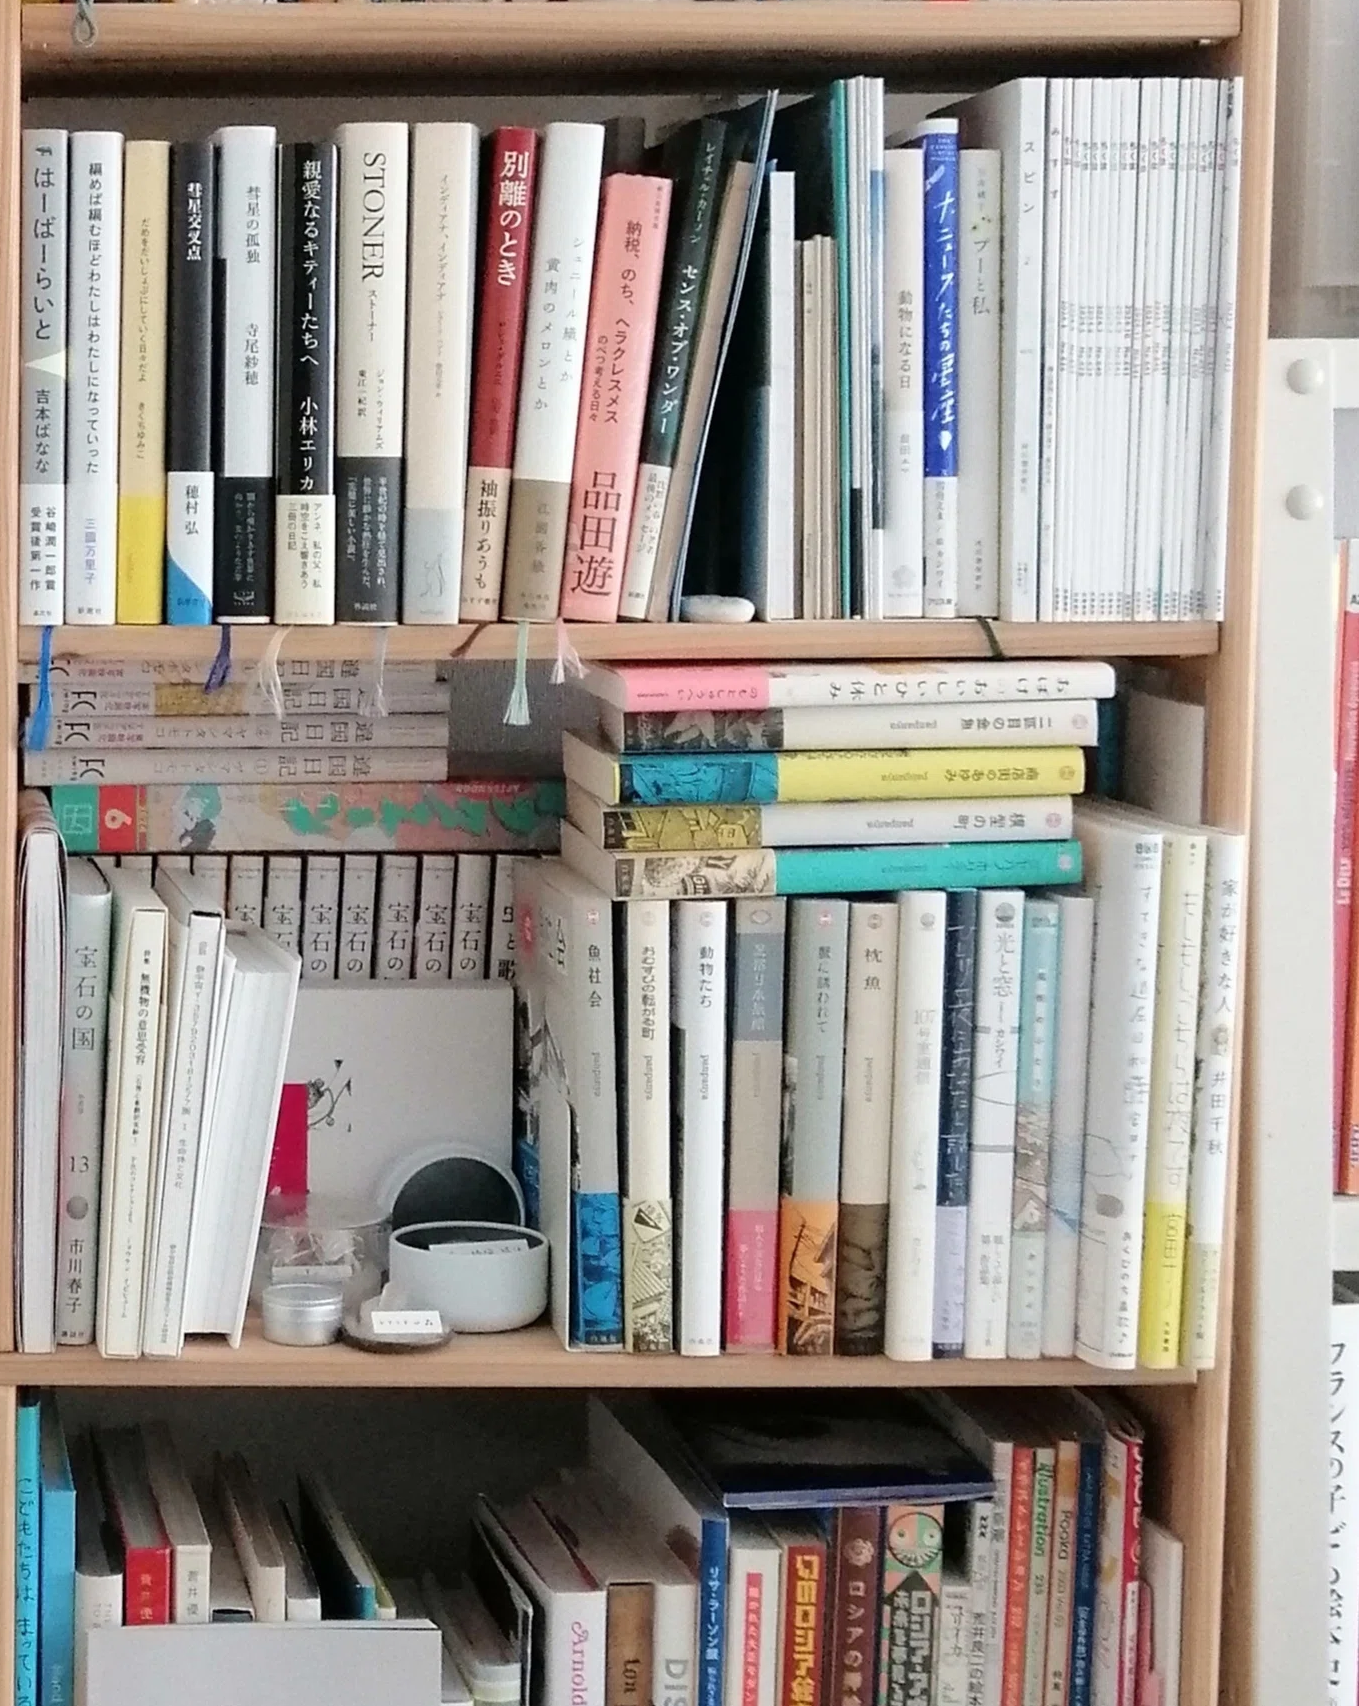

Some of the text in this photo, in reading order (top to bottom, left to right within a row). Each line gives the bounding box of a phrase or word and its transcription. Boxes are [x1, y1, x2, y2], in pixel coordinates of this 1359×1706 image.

[363, 153, 387, 281] STONER
[497, 150, 530, 286] 別離のとき
[85, 162, 104, 474] 編めば編むほどわたしはわたしになっていった
[243, 186, 261, 385] 彗星の孤独 寺尾紗穂
[971, 239, 991, 315] プーと私
[299, 160, 322, 491] 親愛なるキティーたちへ 小林エリカ
[659, 264, 698, 435] センス・オブ・ワンダー
[897, 289, 913, 388] 動物になる日
[34, 389, 51, 475] 吉本ばなな
[45, 506, 57, 590] 谷崎潤一郎賞
[185, 484, 200, 536] 穂村弘
[474, 480, 498, 590] 袖振りあうも
[571, 470, 621, 597] 品田遊
[278, 754, 373, 778] 違国日記
[280, 722, 375, 743] 違国日記
[309, 904, 333, 974] 宝石の
[345, 903, 370, 974] 宝石の
[386, 901, 412, 973] 宝石の
[587, 943, 603, 1008] 魚社会
[699, 945, 715, 1009] 動物たち
[865, 946, 883, 990] 枕魚
[641, 945, 657, 1041] おむすびの転がる町
[1207, 879, 1239, 1157] 家が好きな人 井田千秋
[65, 1155, 91, 1314] 13 市川春子
[17, 1475, 33, 1603] こどもたちは
